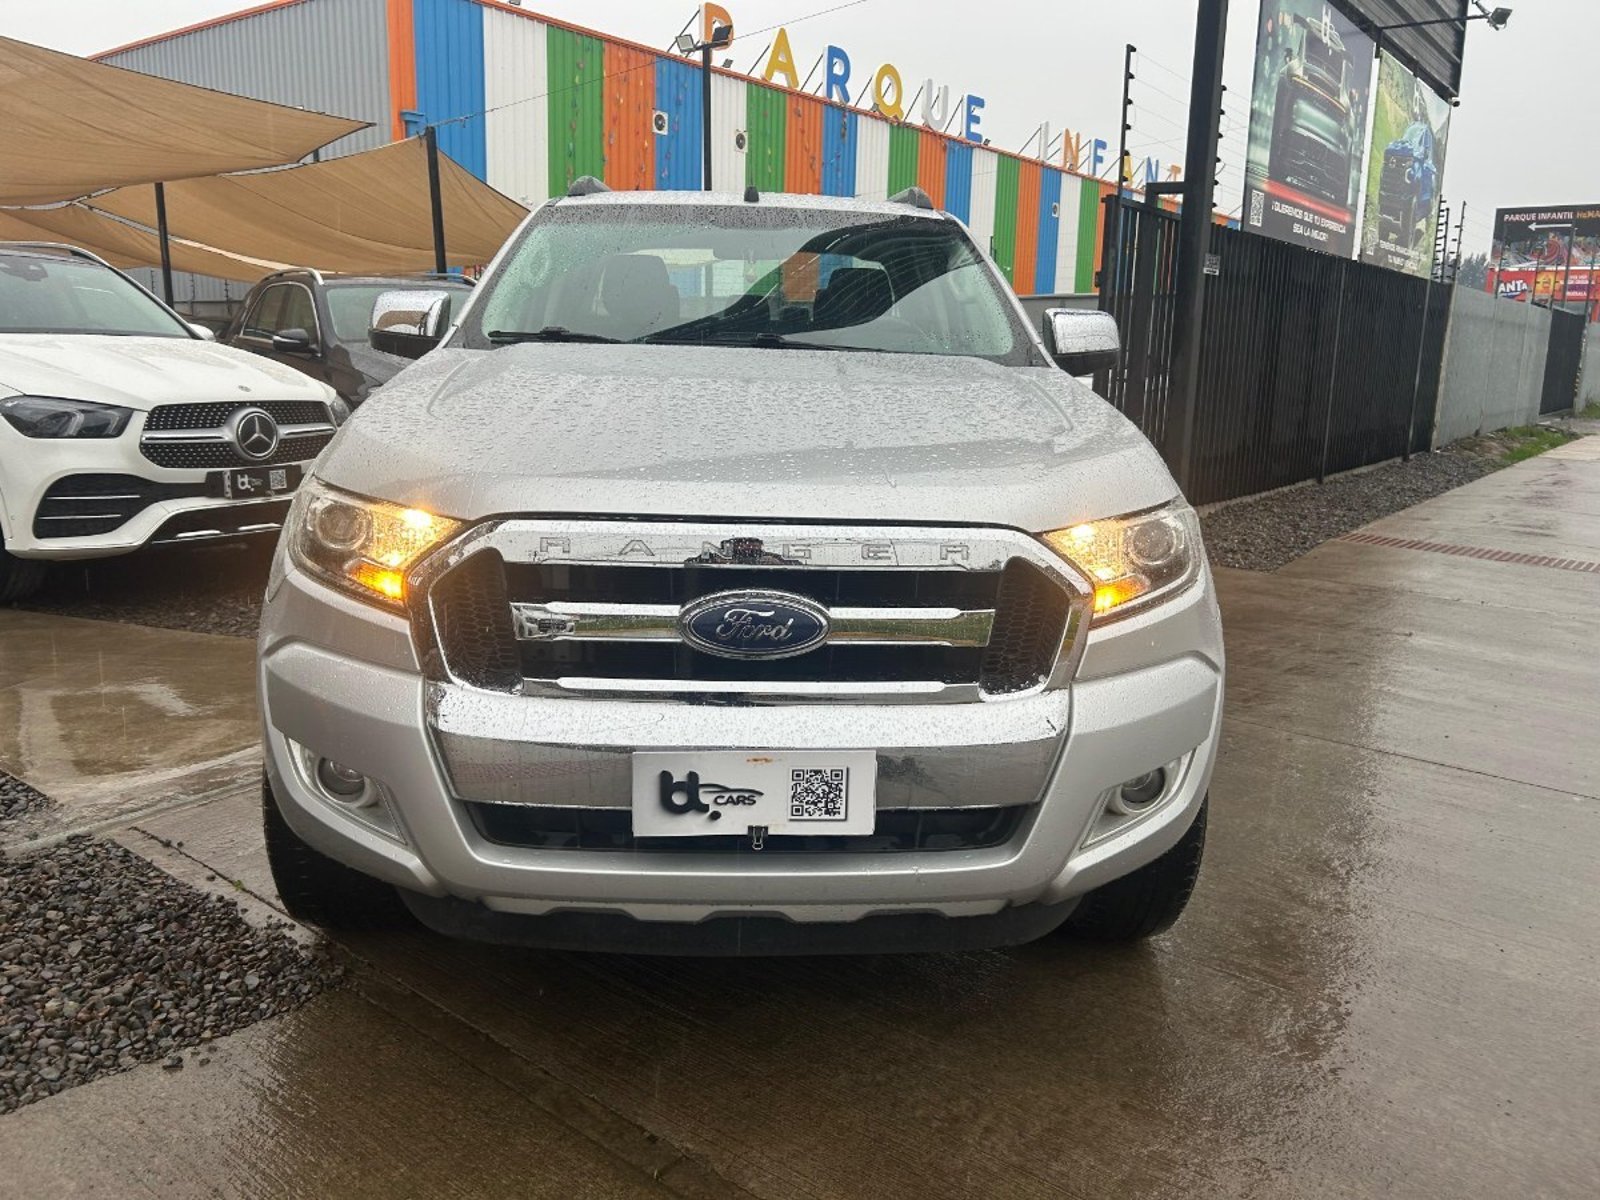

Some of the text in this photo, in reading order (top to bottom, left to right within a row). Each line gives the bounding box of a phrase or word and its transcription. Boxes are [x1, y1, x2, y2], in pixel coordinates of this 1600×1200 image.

[700, 2, 985, 144] PARQUE
[1303, 211, 1314, 223] QUE
[1503, 212, 1537, 222] PARQUE
[1292, 222, 1303, 235] SEA
[539, 536, 970, 560] RANGER
[715, 608, 795, 642] Ford
[714, 795, 757, 806] CARS
